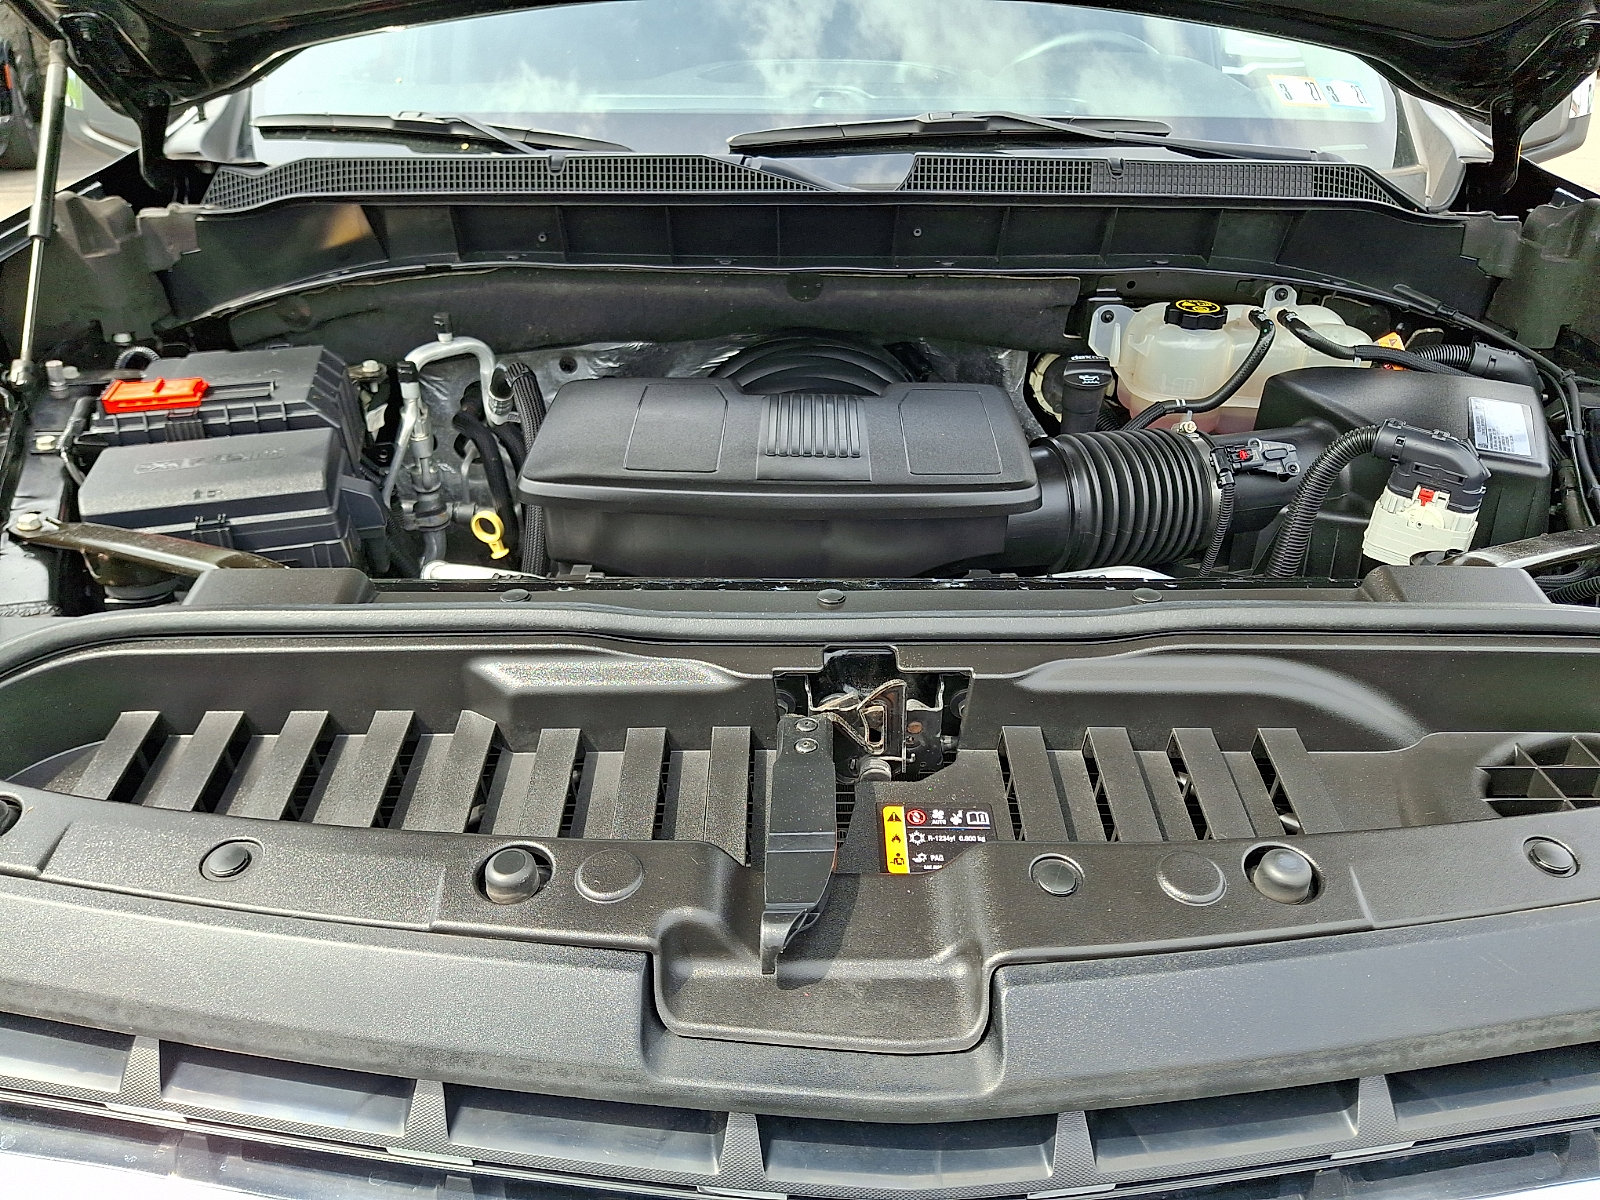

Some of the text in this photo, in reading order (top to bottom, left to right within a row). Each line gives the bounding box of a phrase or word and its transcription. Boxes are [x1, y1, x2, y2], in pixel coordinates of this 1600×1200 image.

[1279, 83, 1293, 101] 3
[1326, 85, 1340, 103] 3
[930, 854, 944, 862] PAG
